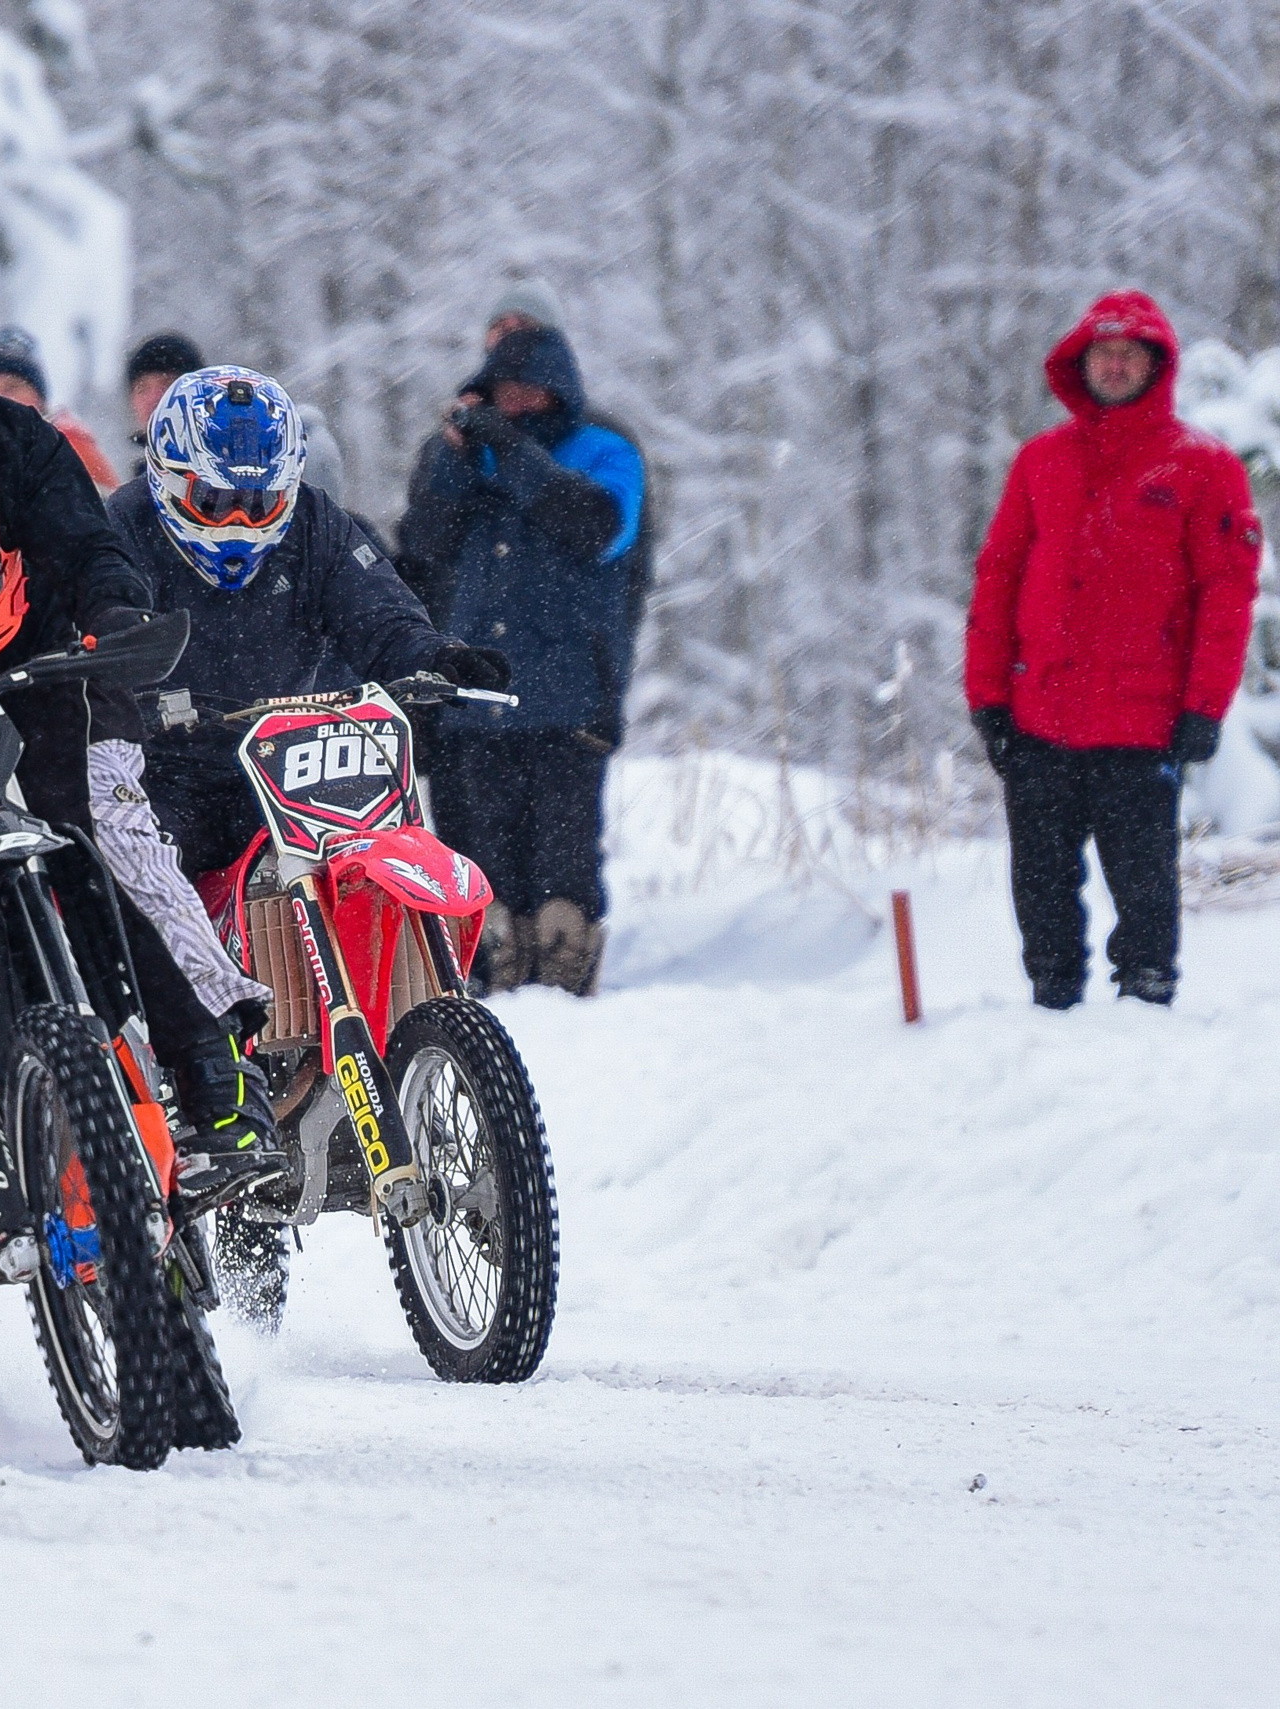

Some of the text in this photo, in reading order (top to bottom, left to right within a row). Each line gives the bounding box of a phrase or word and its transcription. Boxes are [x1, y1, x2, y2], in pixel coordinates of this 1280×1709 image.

[284, 735, 399, 791] 808
[336, 1054, 390, 1176] GEICO
[355, 1050, 384, 1118] HONDA
